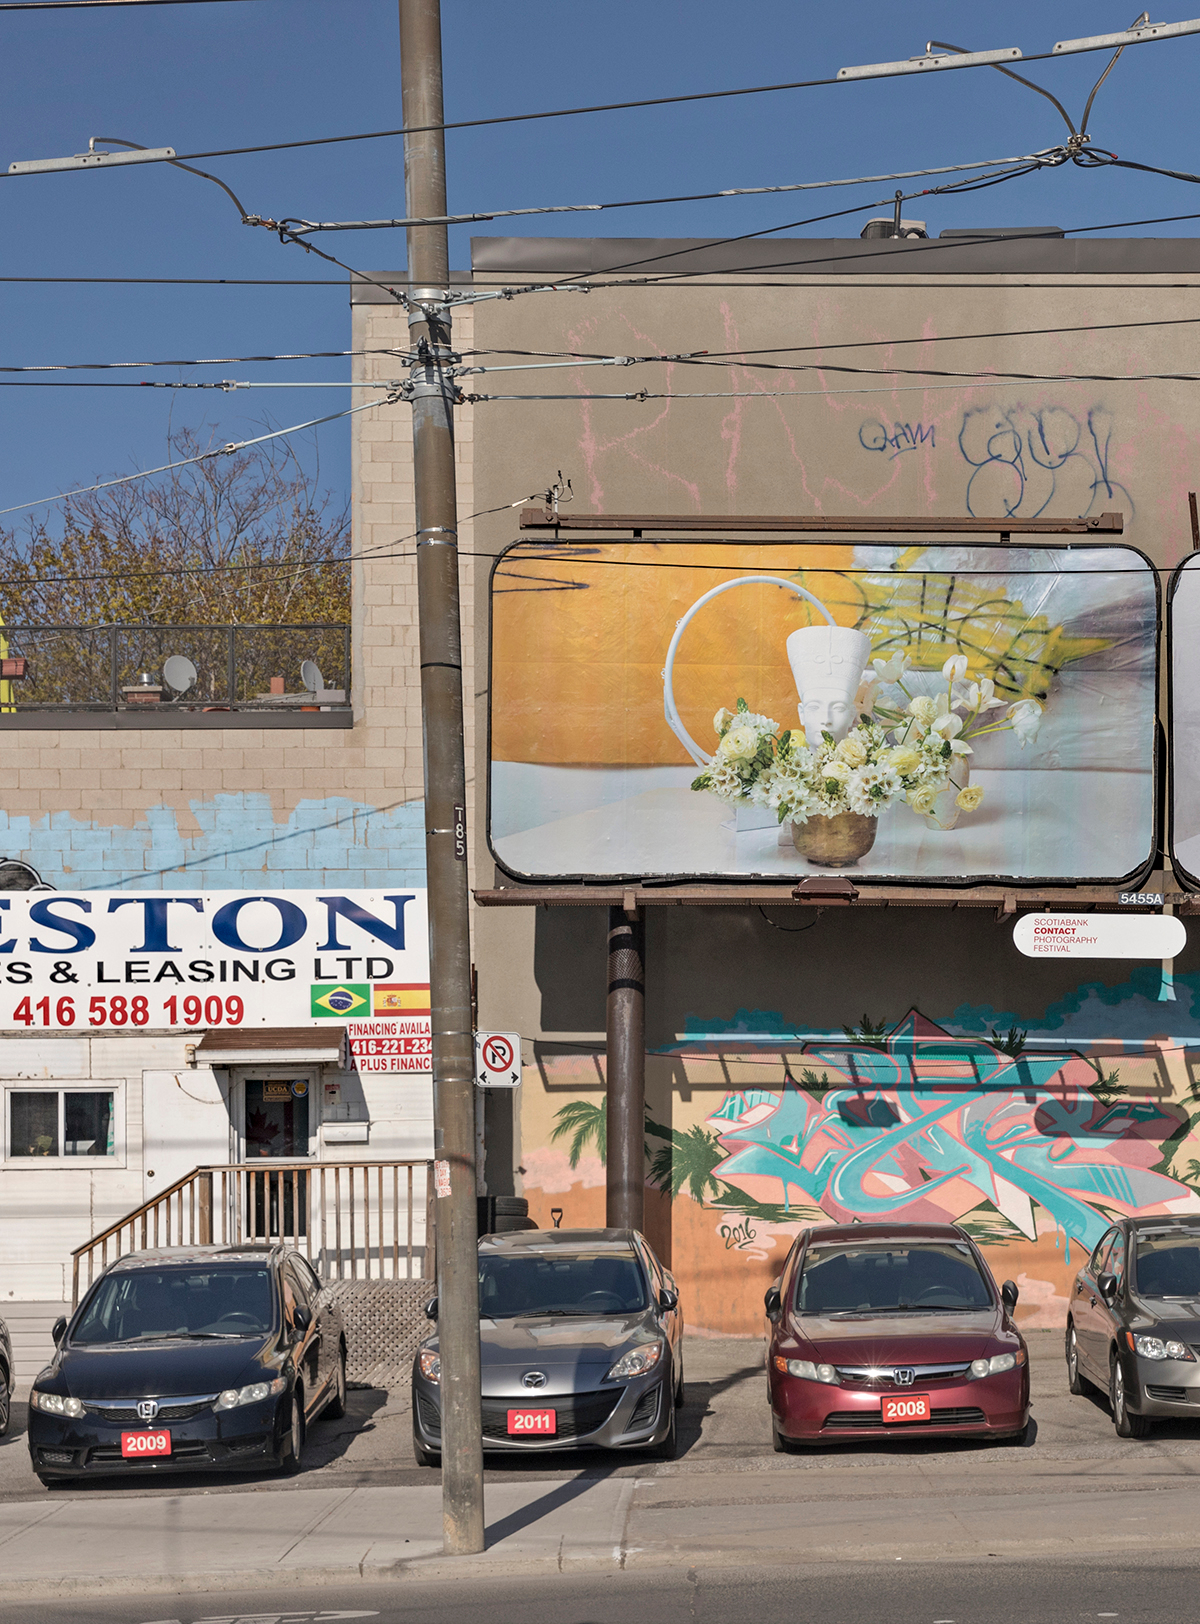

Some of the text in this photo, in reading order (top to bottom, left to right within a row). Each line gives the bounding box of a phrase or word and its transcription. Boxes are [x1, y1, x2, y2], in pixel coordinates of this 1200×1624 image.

[1121, 893, 1163, 905] 5455A
[1034, 918, 1089, 926] SCOTIABANK
[1034, 927, 1076, 935] CONTACT
[1033, 936, 1098, 944] PHOTOGRAPHY
[1033, 944, 1071, 952] FESTIVAL
[49, 960, 80, 984] &
[97, 957, 296, 984] LEASING
[314, 956, 394, 980] LTD
[13, 994, 245, 1027] 416 588 1909
[349, 1022, 397, 1036] FINANCING
[350, 1058, 357, 1071] A
[360, 1058, 388, 1071] PLUS
[720, 1216, 757, 1250] 2016
[887, 1400, 926, 1417] 2008
[514, 1414, 550, 1429] 2011
[126, 1435, 167, 1451] 2009
